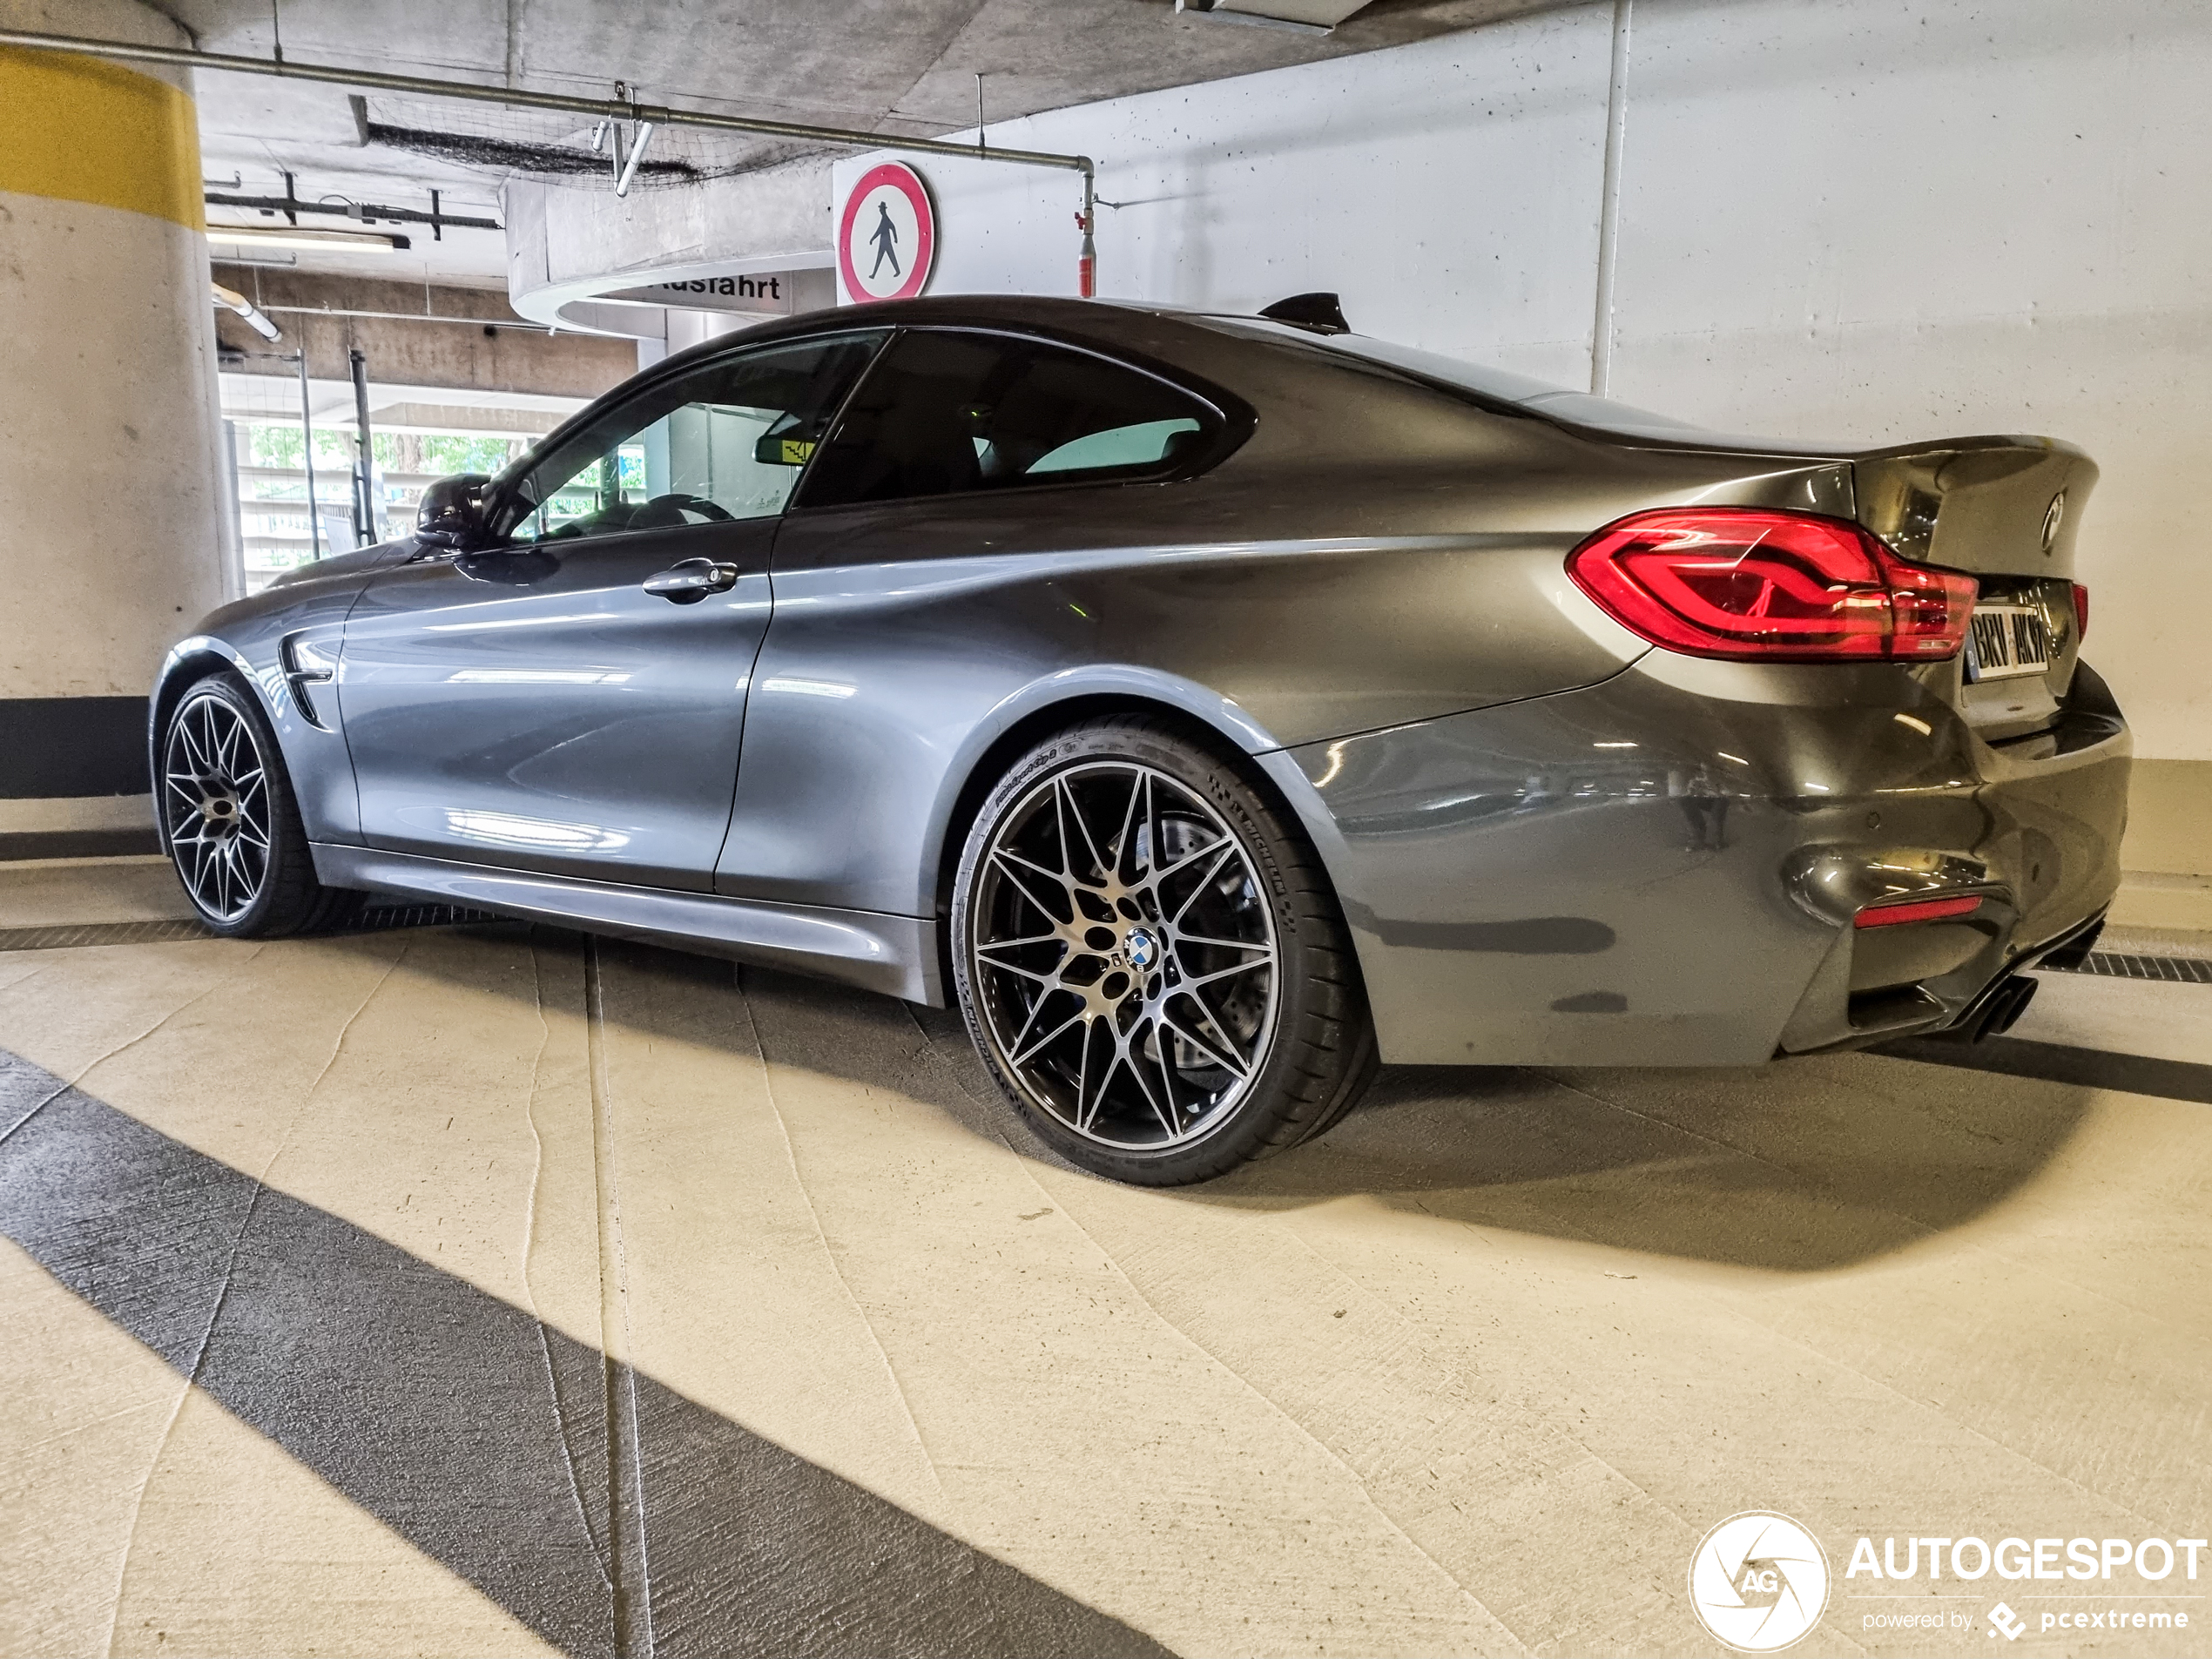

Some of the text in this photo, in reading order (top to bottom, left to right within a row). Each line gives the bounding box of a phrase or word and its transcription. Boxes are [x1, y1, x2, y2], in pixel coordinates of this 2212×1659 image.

[1971, 613, 2009, 669] BRV
[1243, 819, 1285, 894] MICHELIN
[967, 1008, 999, 1074] MICHELIN
